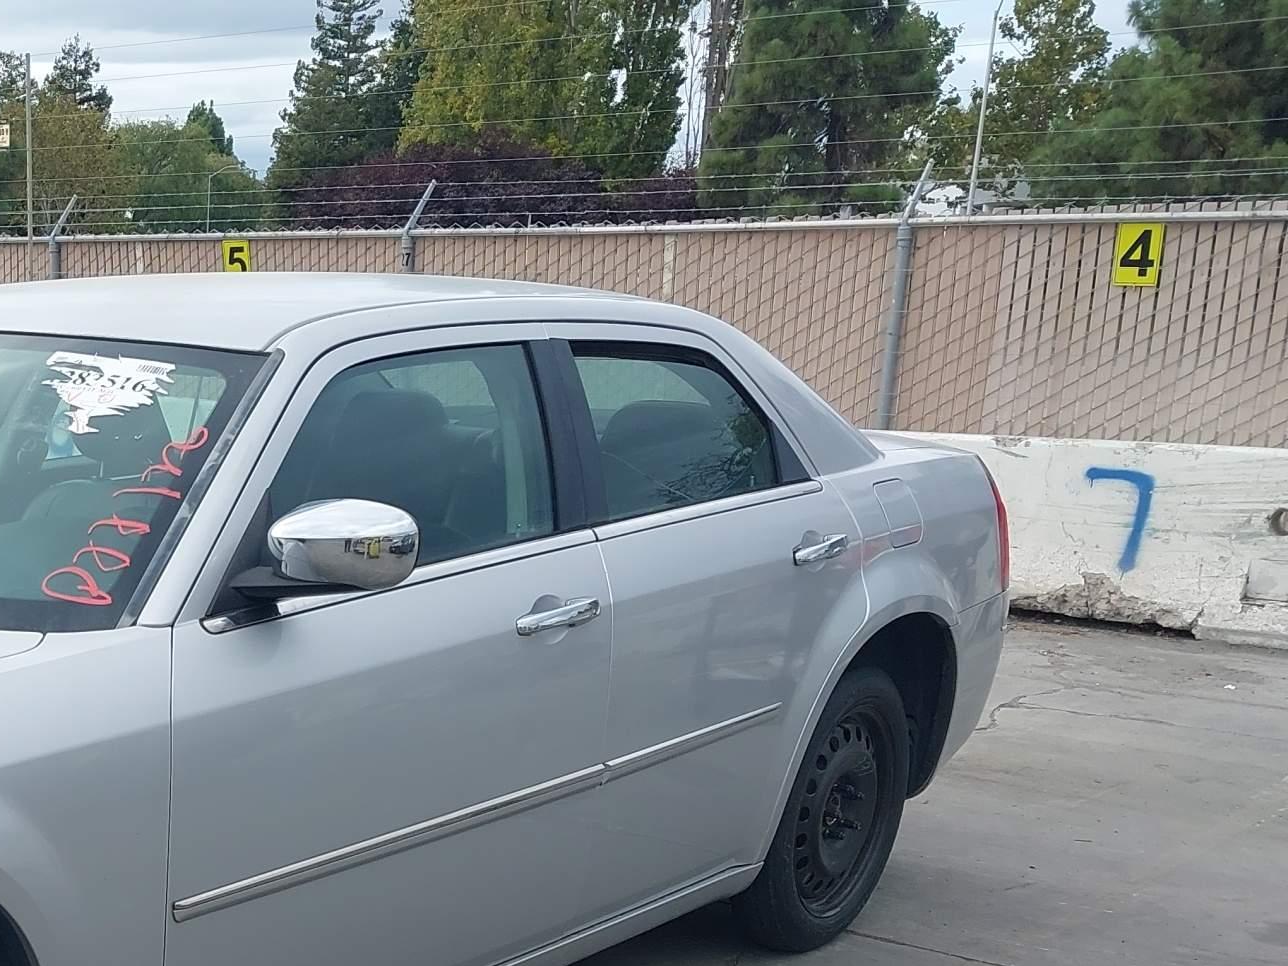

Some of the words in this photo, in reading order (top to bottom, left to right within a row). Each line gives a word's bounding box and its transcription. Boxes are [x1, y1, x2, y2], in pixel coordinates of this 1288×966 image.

[229, 246, 247, 272] 5
[1119, 229, 1155, 277] 4
[1084, 466, 1155, 573] 7
